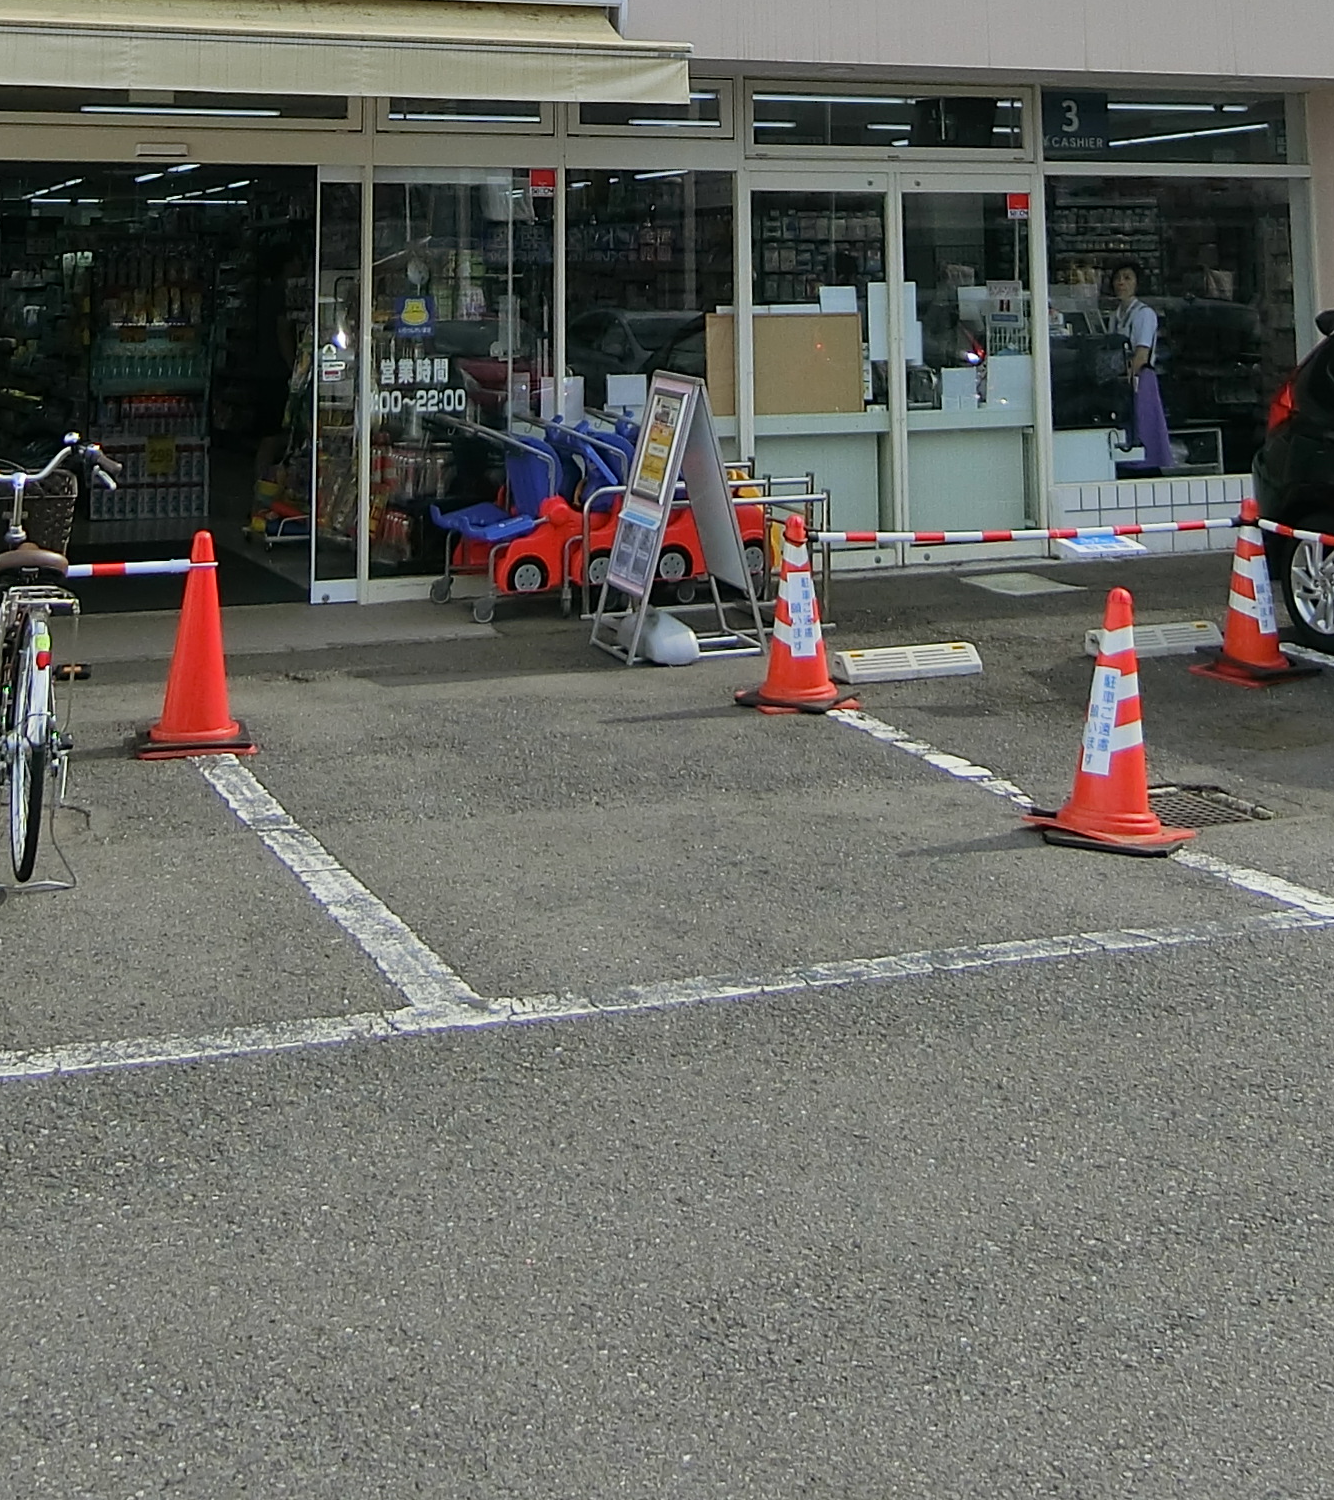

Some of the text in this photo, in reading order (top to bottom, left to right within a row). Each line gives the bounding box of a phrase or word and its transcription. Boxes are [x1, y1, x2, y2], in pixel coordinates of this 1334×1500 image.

[1061, 99, 1080, 132] 3
[380, 357, 449, 384] 営業時間
